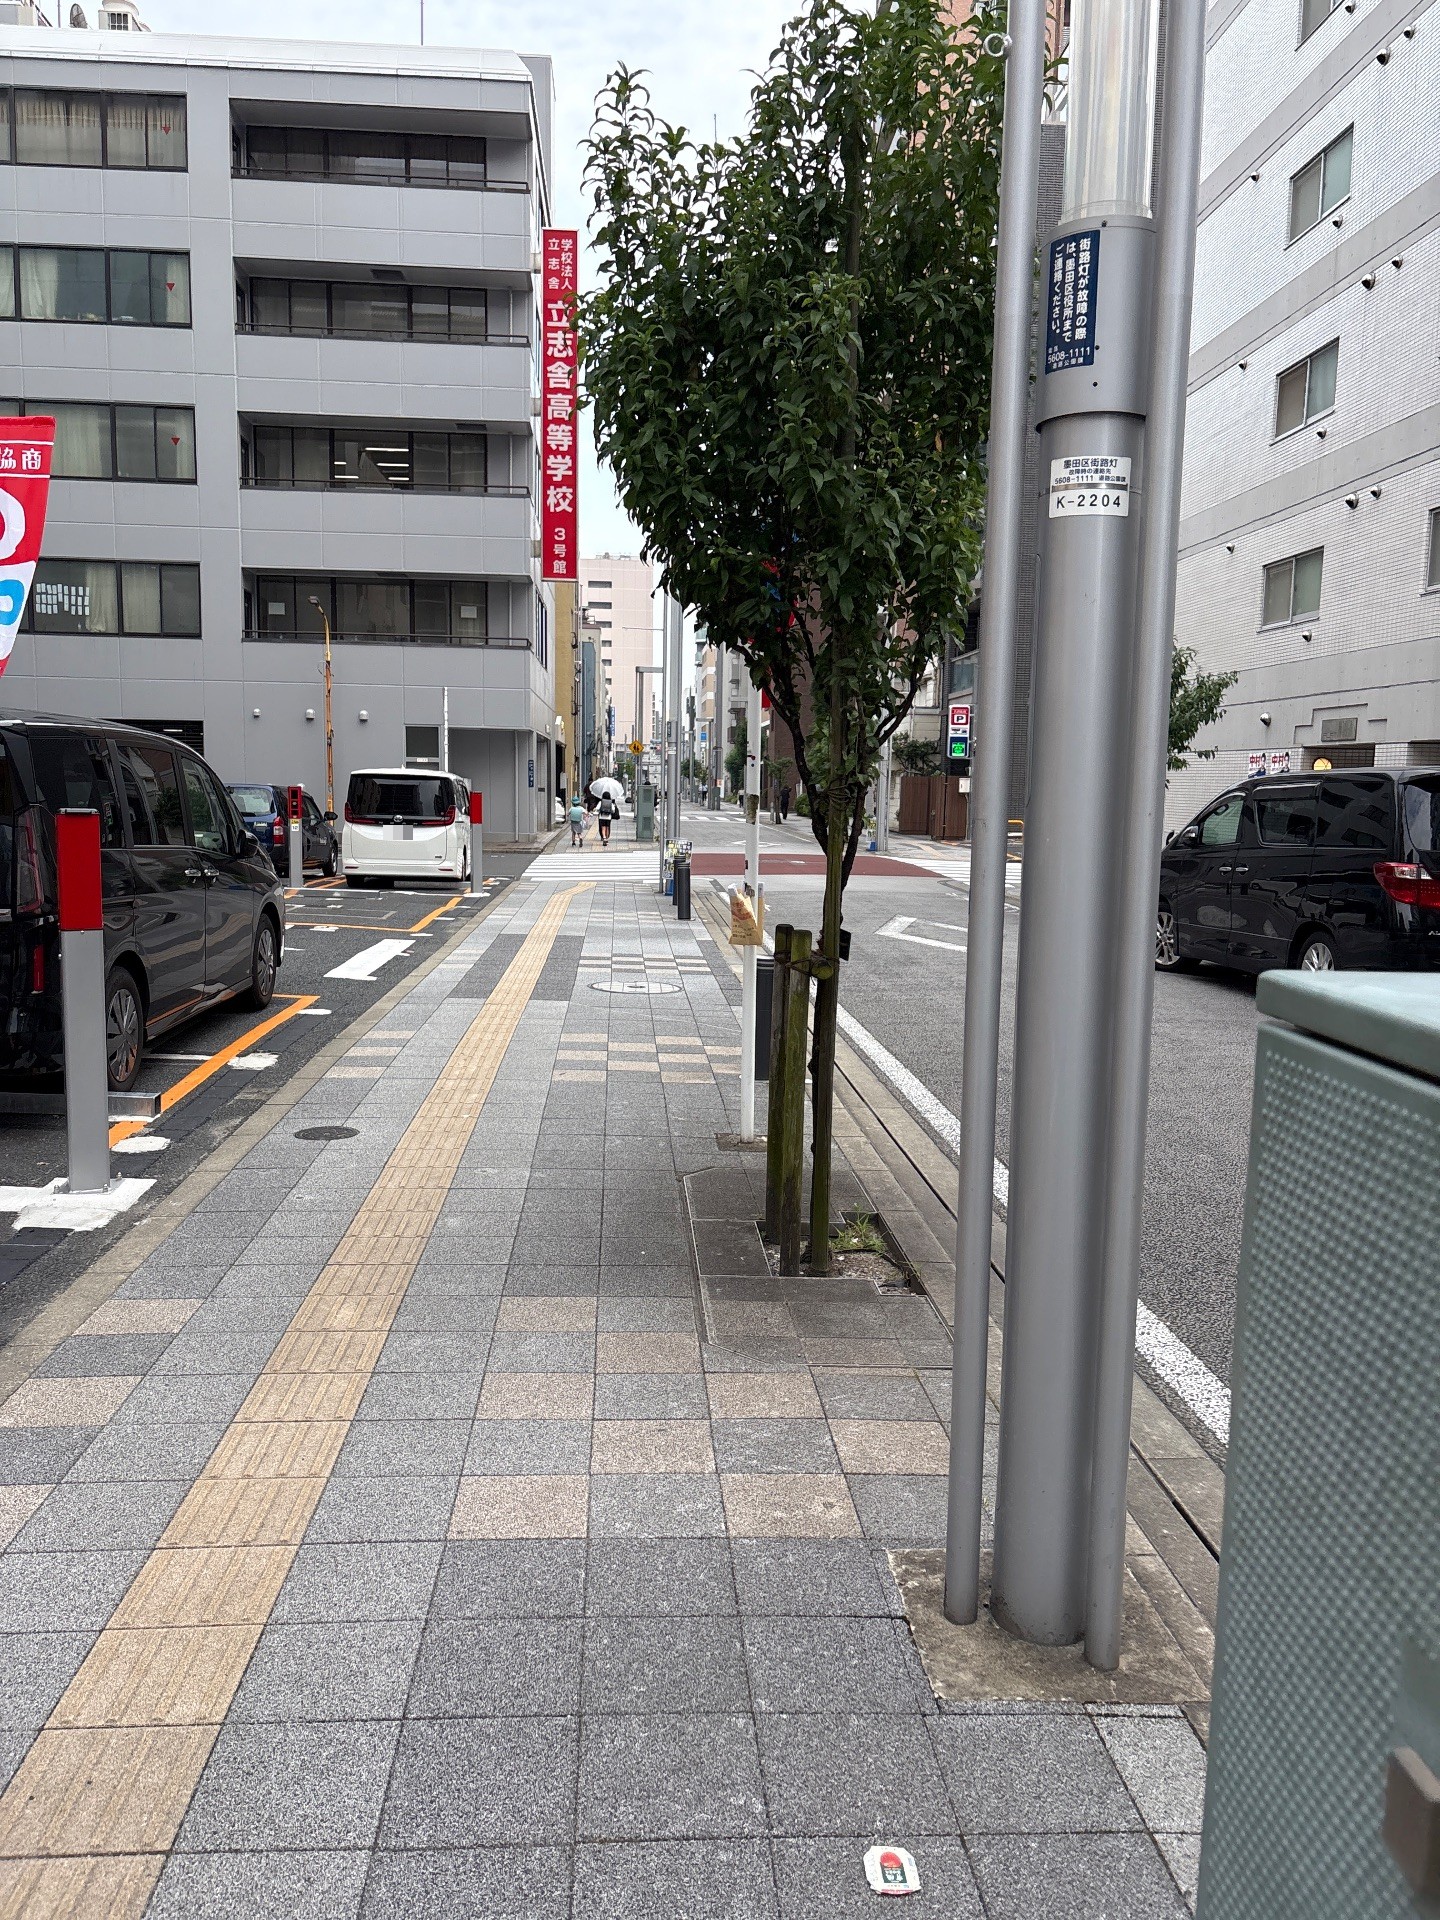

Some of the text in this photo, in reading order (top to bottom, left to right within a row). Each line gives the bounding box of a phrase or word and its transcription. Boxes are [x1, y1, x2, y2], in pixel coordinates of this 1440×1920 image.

[547, 238, 560, 290] 立志舎
[561, 238, 573, 290] 学校法人
[1074, 238, 1091, 341] 街路灯が故障の際
[1047, 346, 1090, 364] 5608-1111
[546, 300, 574, 575] 立志舎高等学校 3号館
[1054, 475, 1094, 484] 5608-1111
[1063, 458, 1118, 469] 墨田区街路灯
[1056, 494, 1121, 509] K-2204
